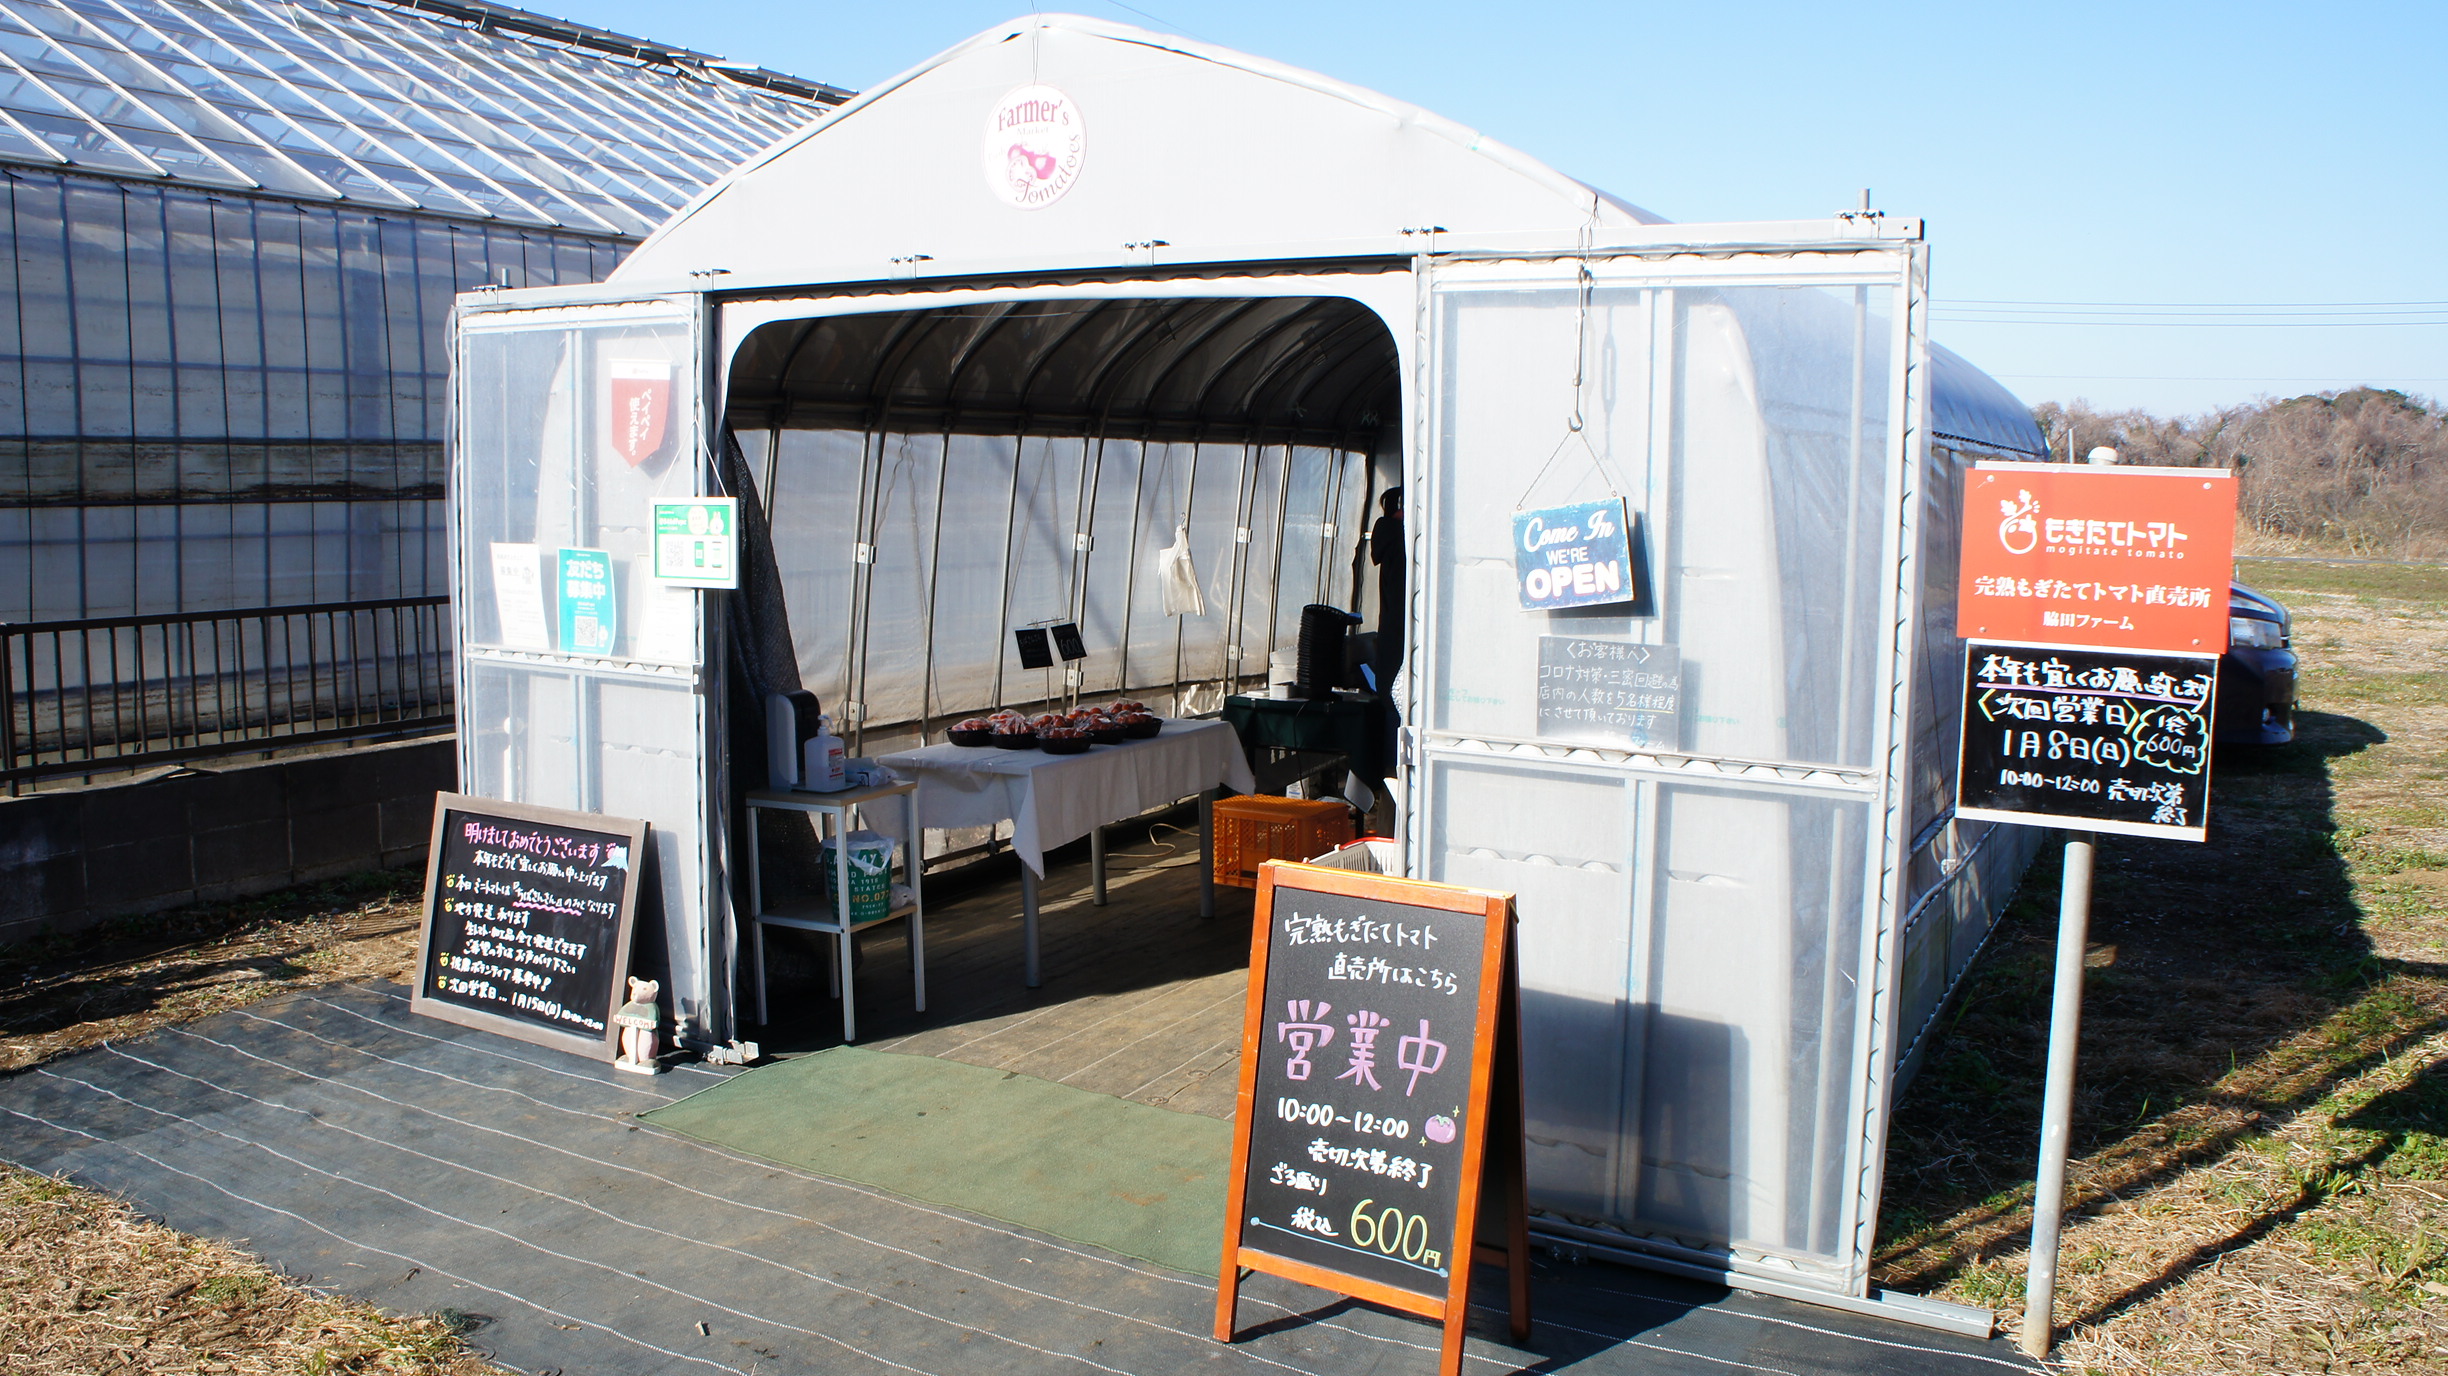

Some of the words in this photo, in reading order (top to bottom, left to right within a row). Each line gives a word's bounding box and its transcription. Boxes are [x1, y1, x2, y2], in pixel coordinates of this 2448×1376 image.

[998, 99, 1069, 132] Farmer's
[1015, 134, 1080, 204] Tomatoes
[628, 397, 641, 456] 使えます。
[640, 388, 653, 441] ペイペイ
[1523, 517, 1579, 552] Come
[1584, 509, 1615, 541] In
[2045, 517, 2189, 549] もぎたてトマト
[1545, 546, 1589, 566] WE'RE
[2046, 545, 2118, 558] mogitate
[2127, 548, 2185, 560] tomato
[1526, 560, 1620, 600] OPEN
[1974, 575, 2212, 609] 完熟もぎたてトマト直売所
[2043, 611, 2135, 631] 脇田ファーム
[1284, 911, 1438, 951] 完熟もぎたてトマト
[1328, 952, 1458, 995] 直売所はこちら
[615, 1015, 655, 1030] WELCOME
[1278, 998, 1448, 1098] 営業中
[1308, 1138, 1433, 1189] 売切次第終了
